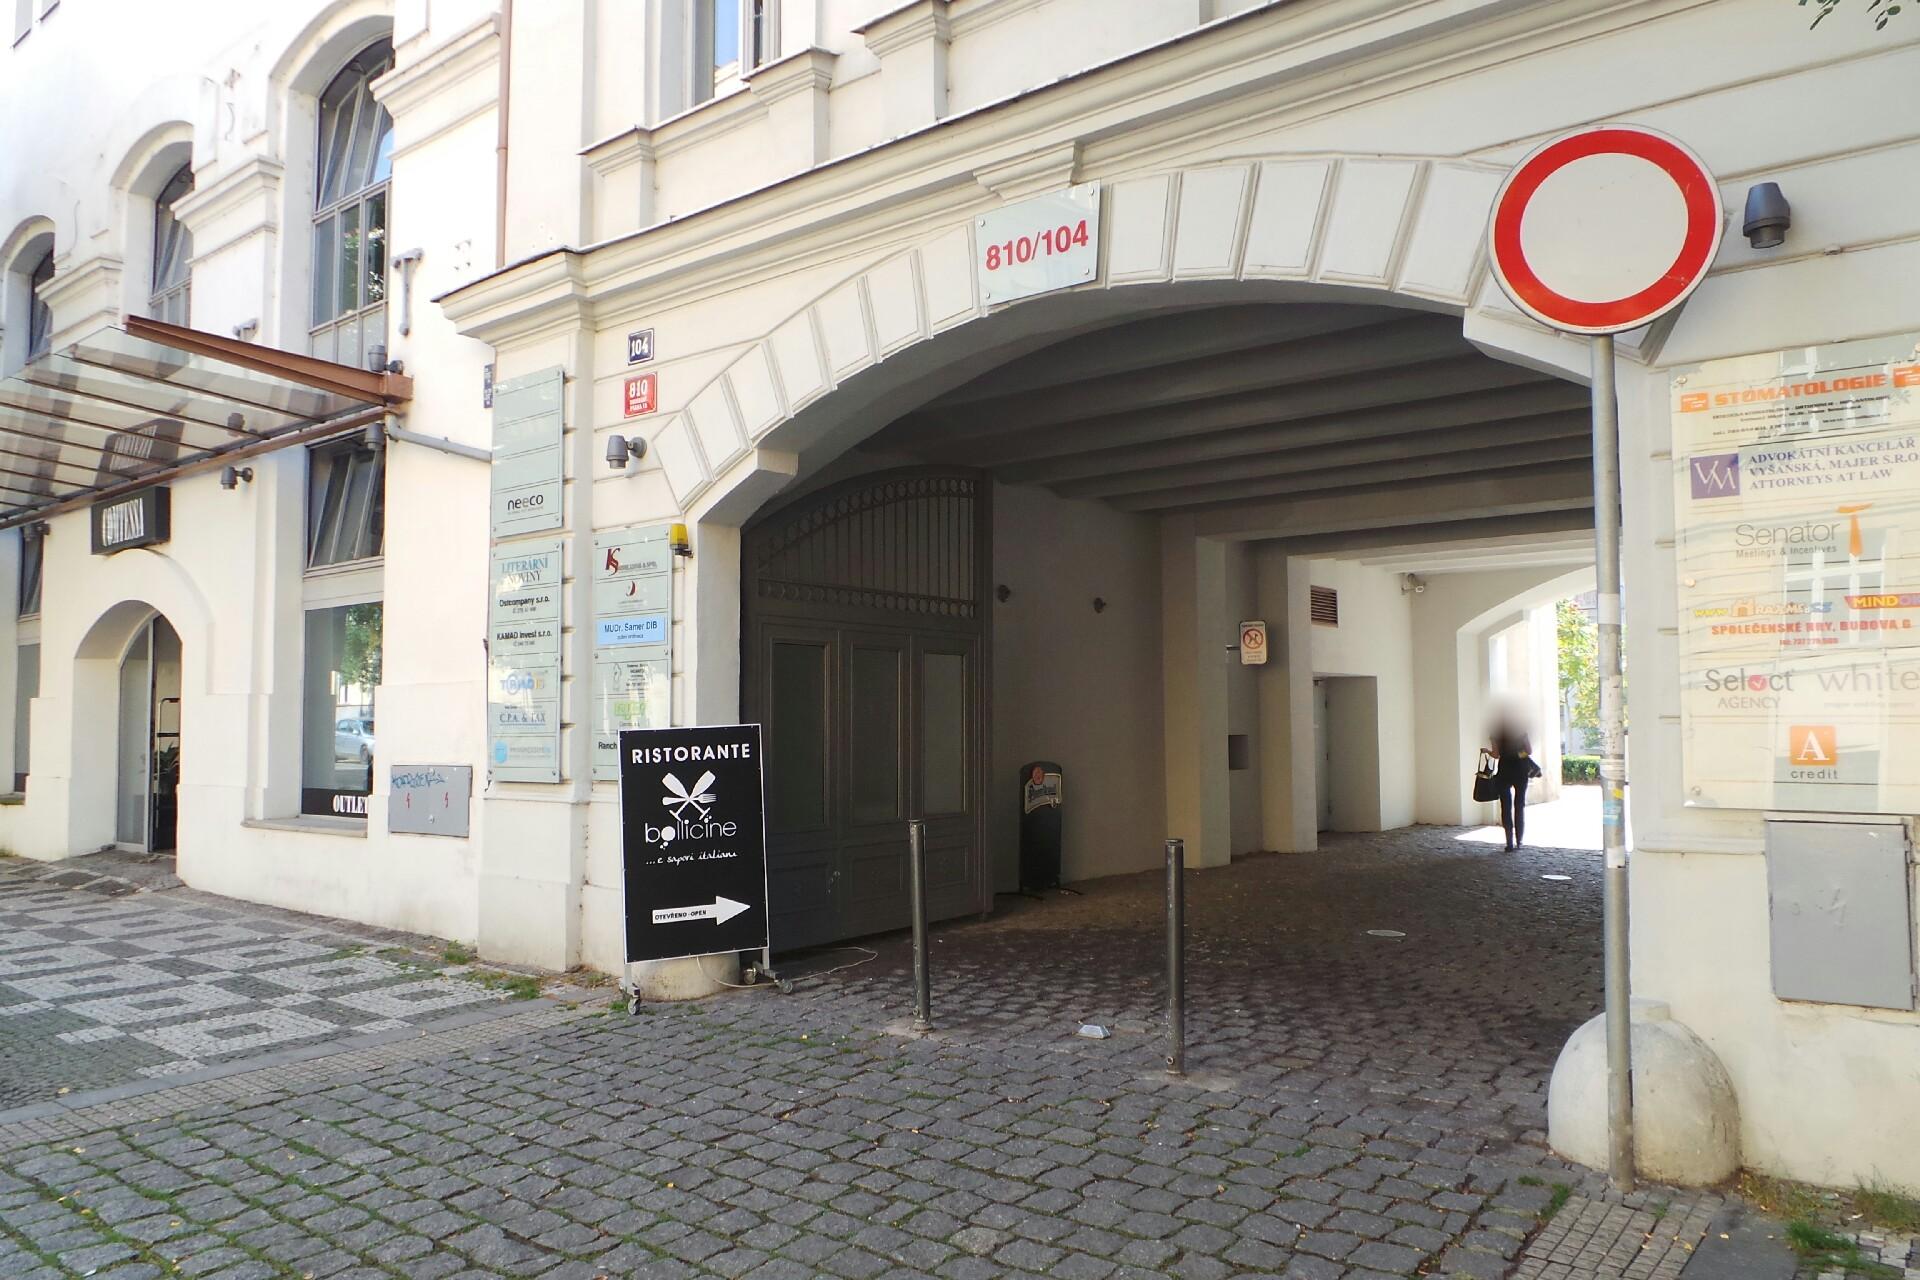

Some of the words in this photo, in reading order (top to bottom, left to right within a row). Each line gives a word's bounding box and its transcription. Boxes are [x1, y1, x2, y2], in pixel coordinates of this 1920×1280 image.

[985, 219, 1090, 271] 810/104
[631, 337, 649, 356] 104
[629, 379, 648, 398] 810
[1714, 373, 1888, 406] STOMATOLOGIE
[1749, 446, 1832, 465] ADVOKÁTNÍ
[1834, 436, 1916, 456] KANCELÁŘ
[1829, 455, 1879, 469] MAJER
[1749, 471, 1833, 490] ATTORNEYS
[1836, 472, 1854, 483] AT
[1859, 468, 1893, 480] LAW
[507, 494, 544, 511] neeco
[1735, 520, 1840, 547] Senator
[502, 555, 548, 574] LITERÁRNÍ
[624, 622, 645, 632] Samer
[645, 620, 658, 630] DIB
[1711, 621, 1803, 636] SPOLEČENSKÉ
[1717, 696, 1781, 710] AGENCY
[631, 743, 751, 764] RISTORANTE
[1796, 729, 1830, 761] A
[1790, 768, 1839, 780] credit
[644, 818, 738, 844] bollicine
[666, 852, 695, 867] sapori
[697, 848, 739, 860] italiani
[654, 911, 688, 921] OTEVŘENO
[690, 908, 707, 917] OPEN
